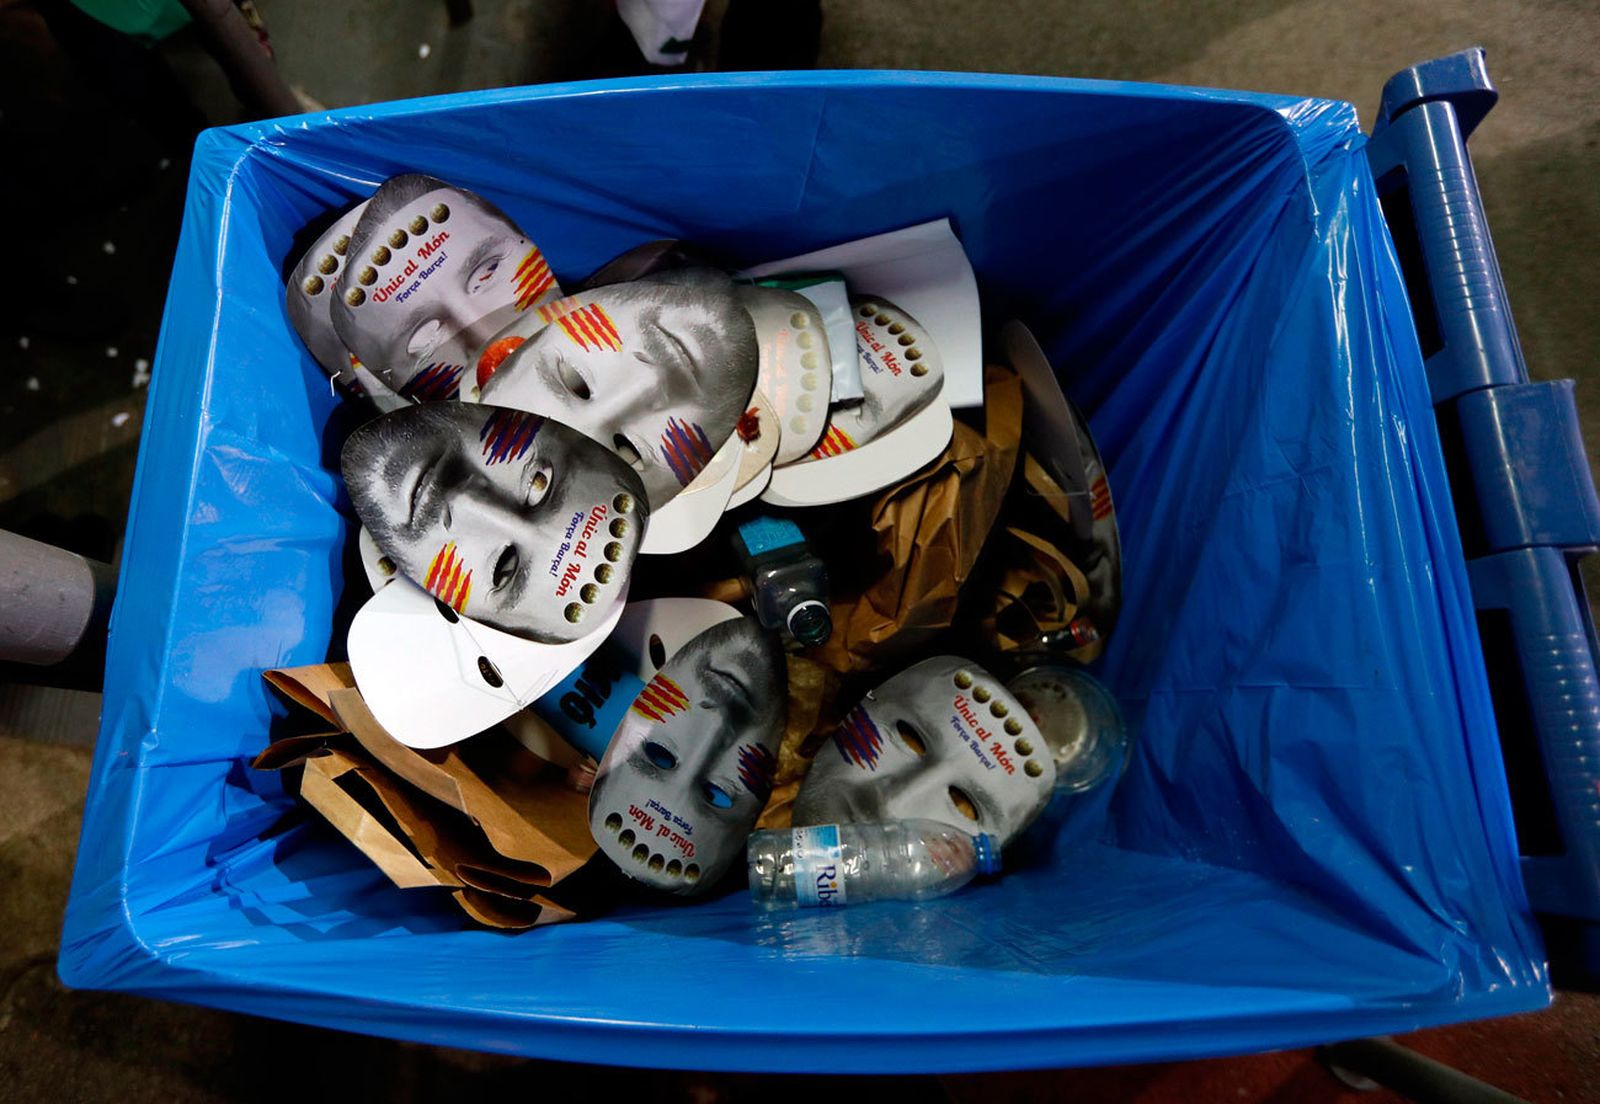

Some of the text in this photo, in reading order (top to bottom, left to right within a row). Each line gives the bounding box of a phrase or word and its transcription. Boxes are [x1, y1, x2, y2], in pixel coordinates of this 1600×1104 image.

[372, 231, 450, 303] Únic al Món
[395, 251, 448, 303] Força Barça!
[556, 504, 608, 597] Únic al Món
[565, 511, 585, 540] Força
[953, 694, 1016, 775] Únic al Món
[628, 804, 695, 858] Únic al Món
